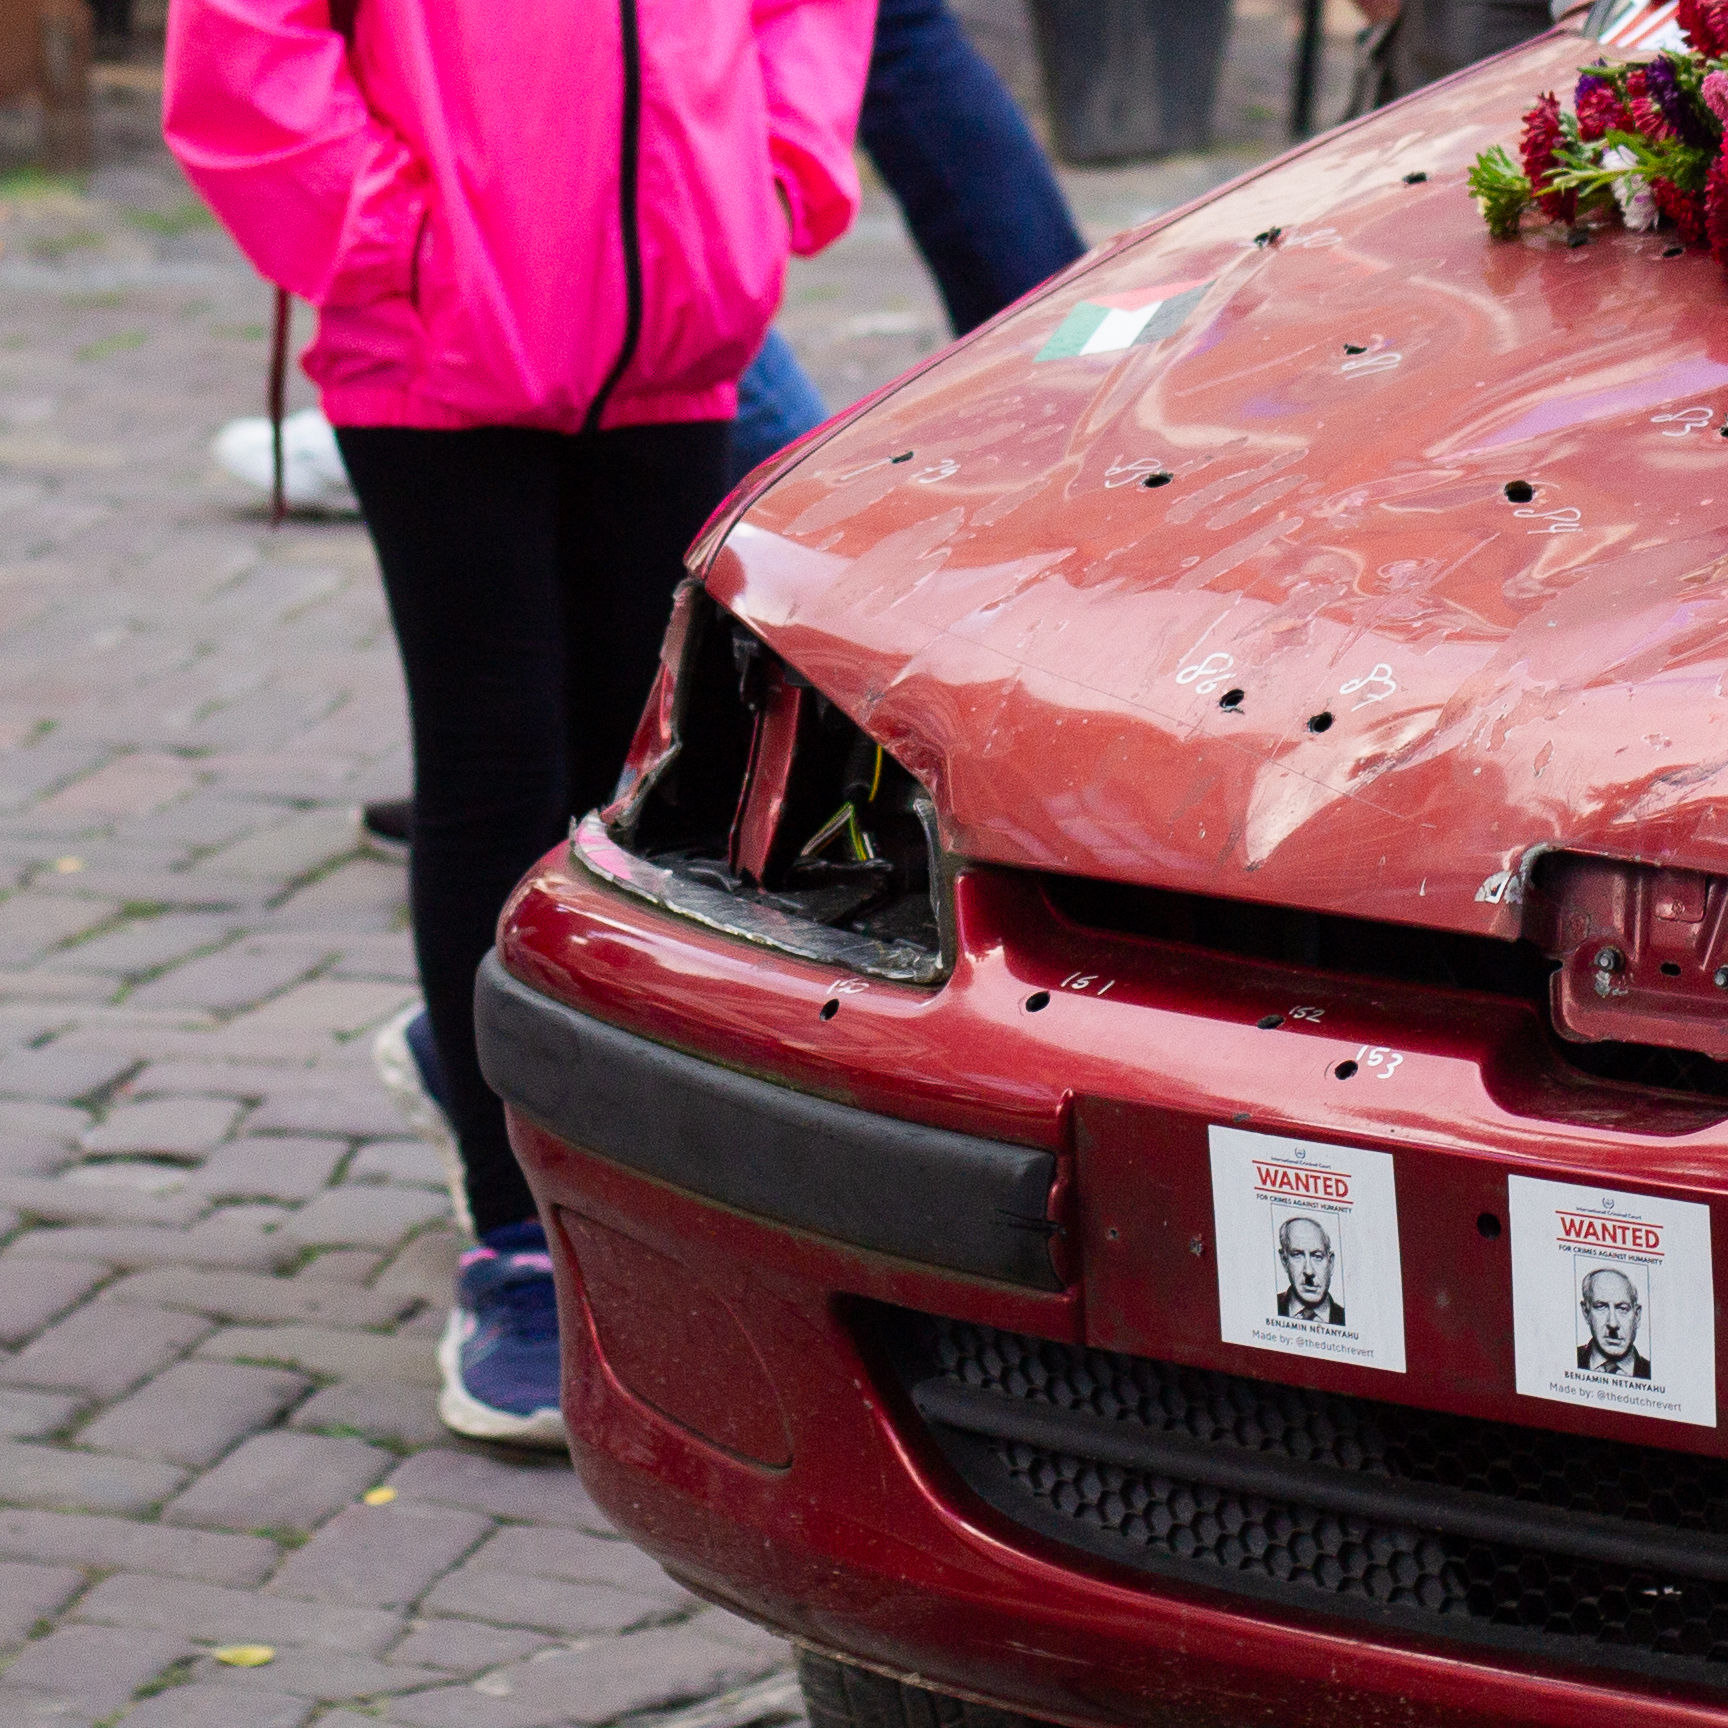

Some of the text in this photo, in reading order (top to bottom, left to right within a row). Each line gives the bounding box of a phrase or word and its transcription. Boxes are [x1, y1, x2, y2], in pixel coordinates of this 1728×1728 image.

[1176, 652, 1236, 695] 86
[1060, 971, 1116, 996] 151
[1288, 1005, 1325, 1024] 152
[1355, 1045, 1405, 1080] 153
[1256, 1166, 1350, 1198] WANTED
[1256, 1193, 1352, 1214] FOR CRIMES AGAINST HUMANITY
[1560, 1216, 1660, 1249] WANTED
[1558, 1244, 1663, 1266] FOR CRIMES AGAINST HUMANITY
[1252, 1329, 1277, 1343] Made
[1279, 1334, 1293, 1346] by:
[1265, 1317, 1360, 1341] BENJAMIN NETANYAHU
[1549, 1381, 1577, 1395] Made
[1578, 1385, 1594, 1399] by:
[1564, 1370, 1666, 1394] BENJAMIN NETANYAHU
